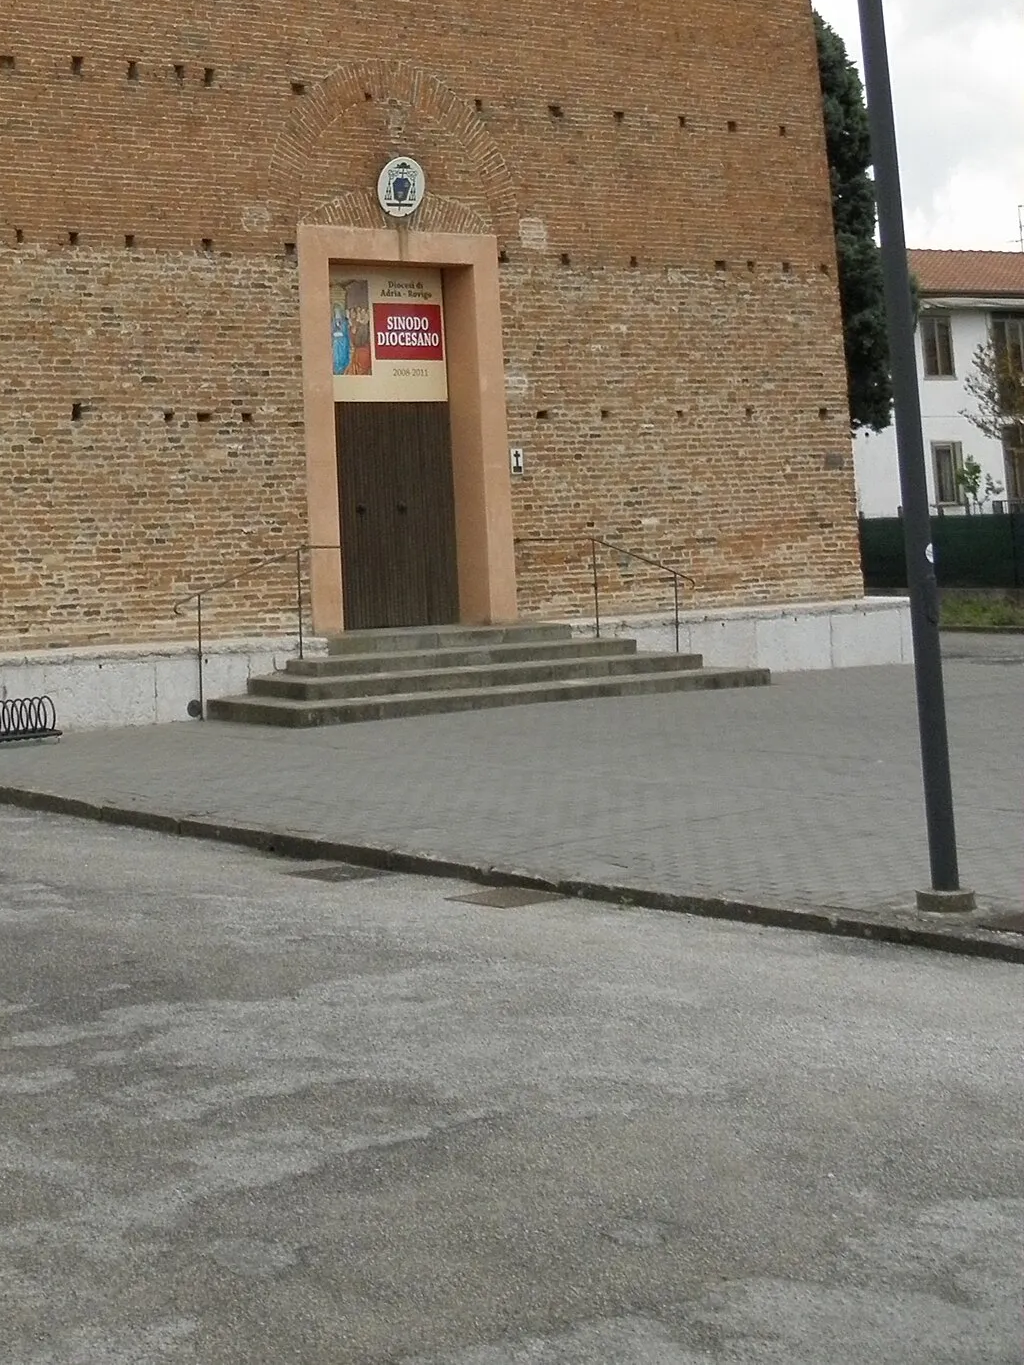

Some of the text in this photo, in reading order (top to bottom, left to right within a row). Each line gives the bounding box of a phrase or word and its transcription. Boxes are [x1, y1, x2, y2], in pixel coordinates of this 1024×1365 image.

[388, 280, 415, 289] Diocesi
[380, 289, 402, 297] Adria
[408, 290, 432, 300] Rovigo
[387, 316, 429, 331] SINODO
[377, 332, 439, 347] DIOCESANO
